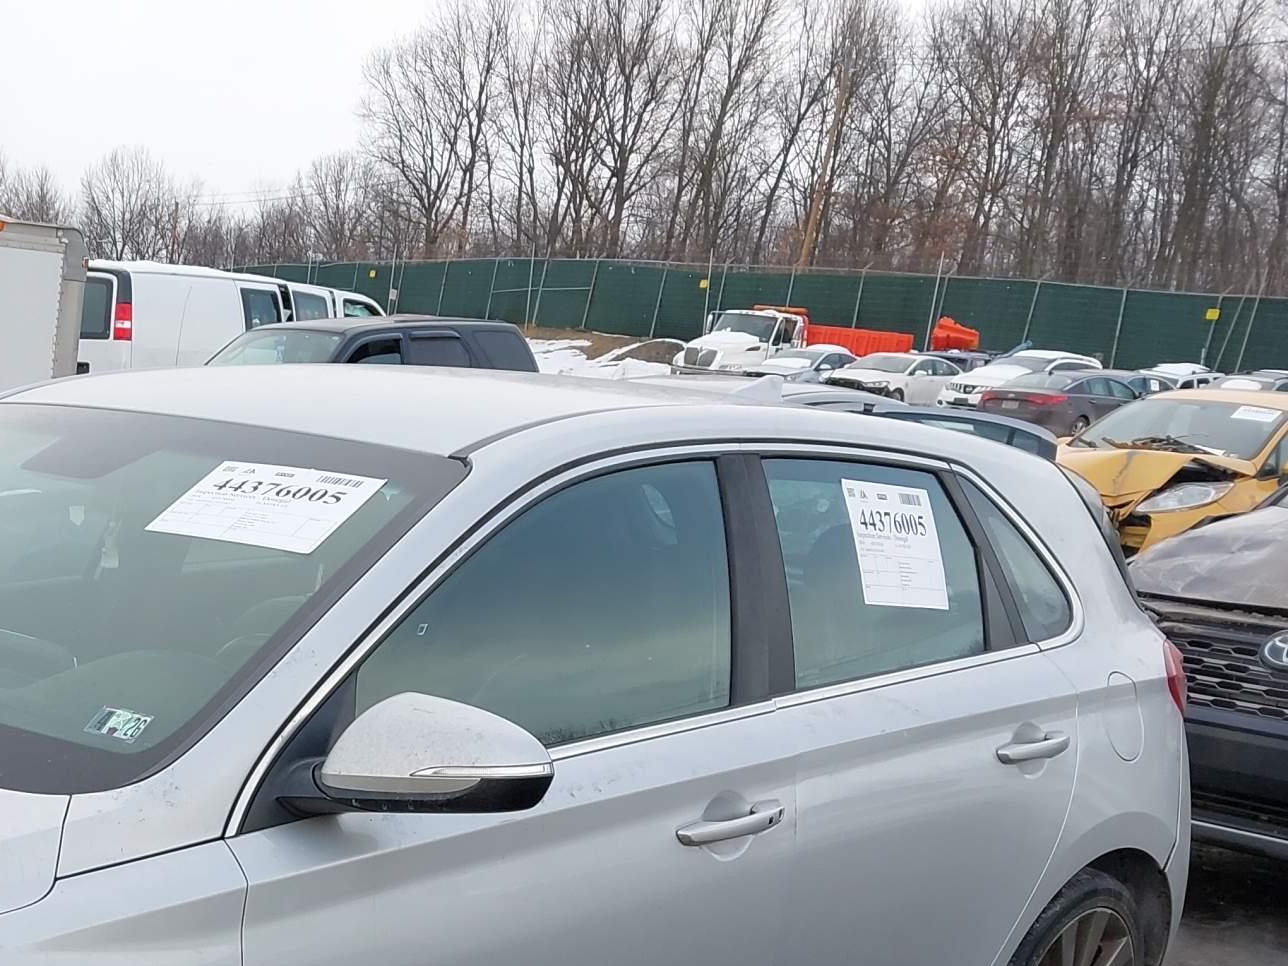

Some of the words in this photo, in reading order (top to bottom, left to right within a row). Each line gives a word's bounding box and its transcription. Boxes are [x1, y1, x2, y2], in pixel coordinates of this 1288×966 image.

[213, 477, 348, 505] 44376005
[859, 508, 927, 537] 44376005
[123, 717, 148, 738] 26
